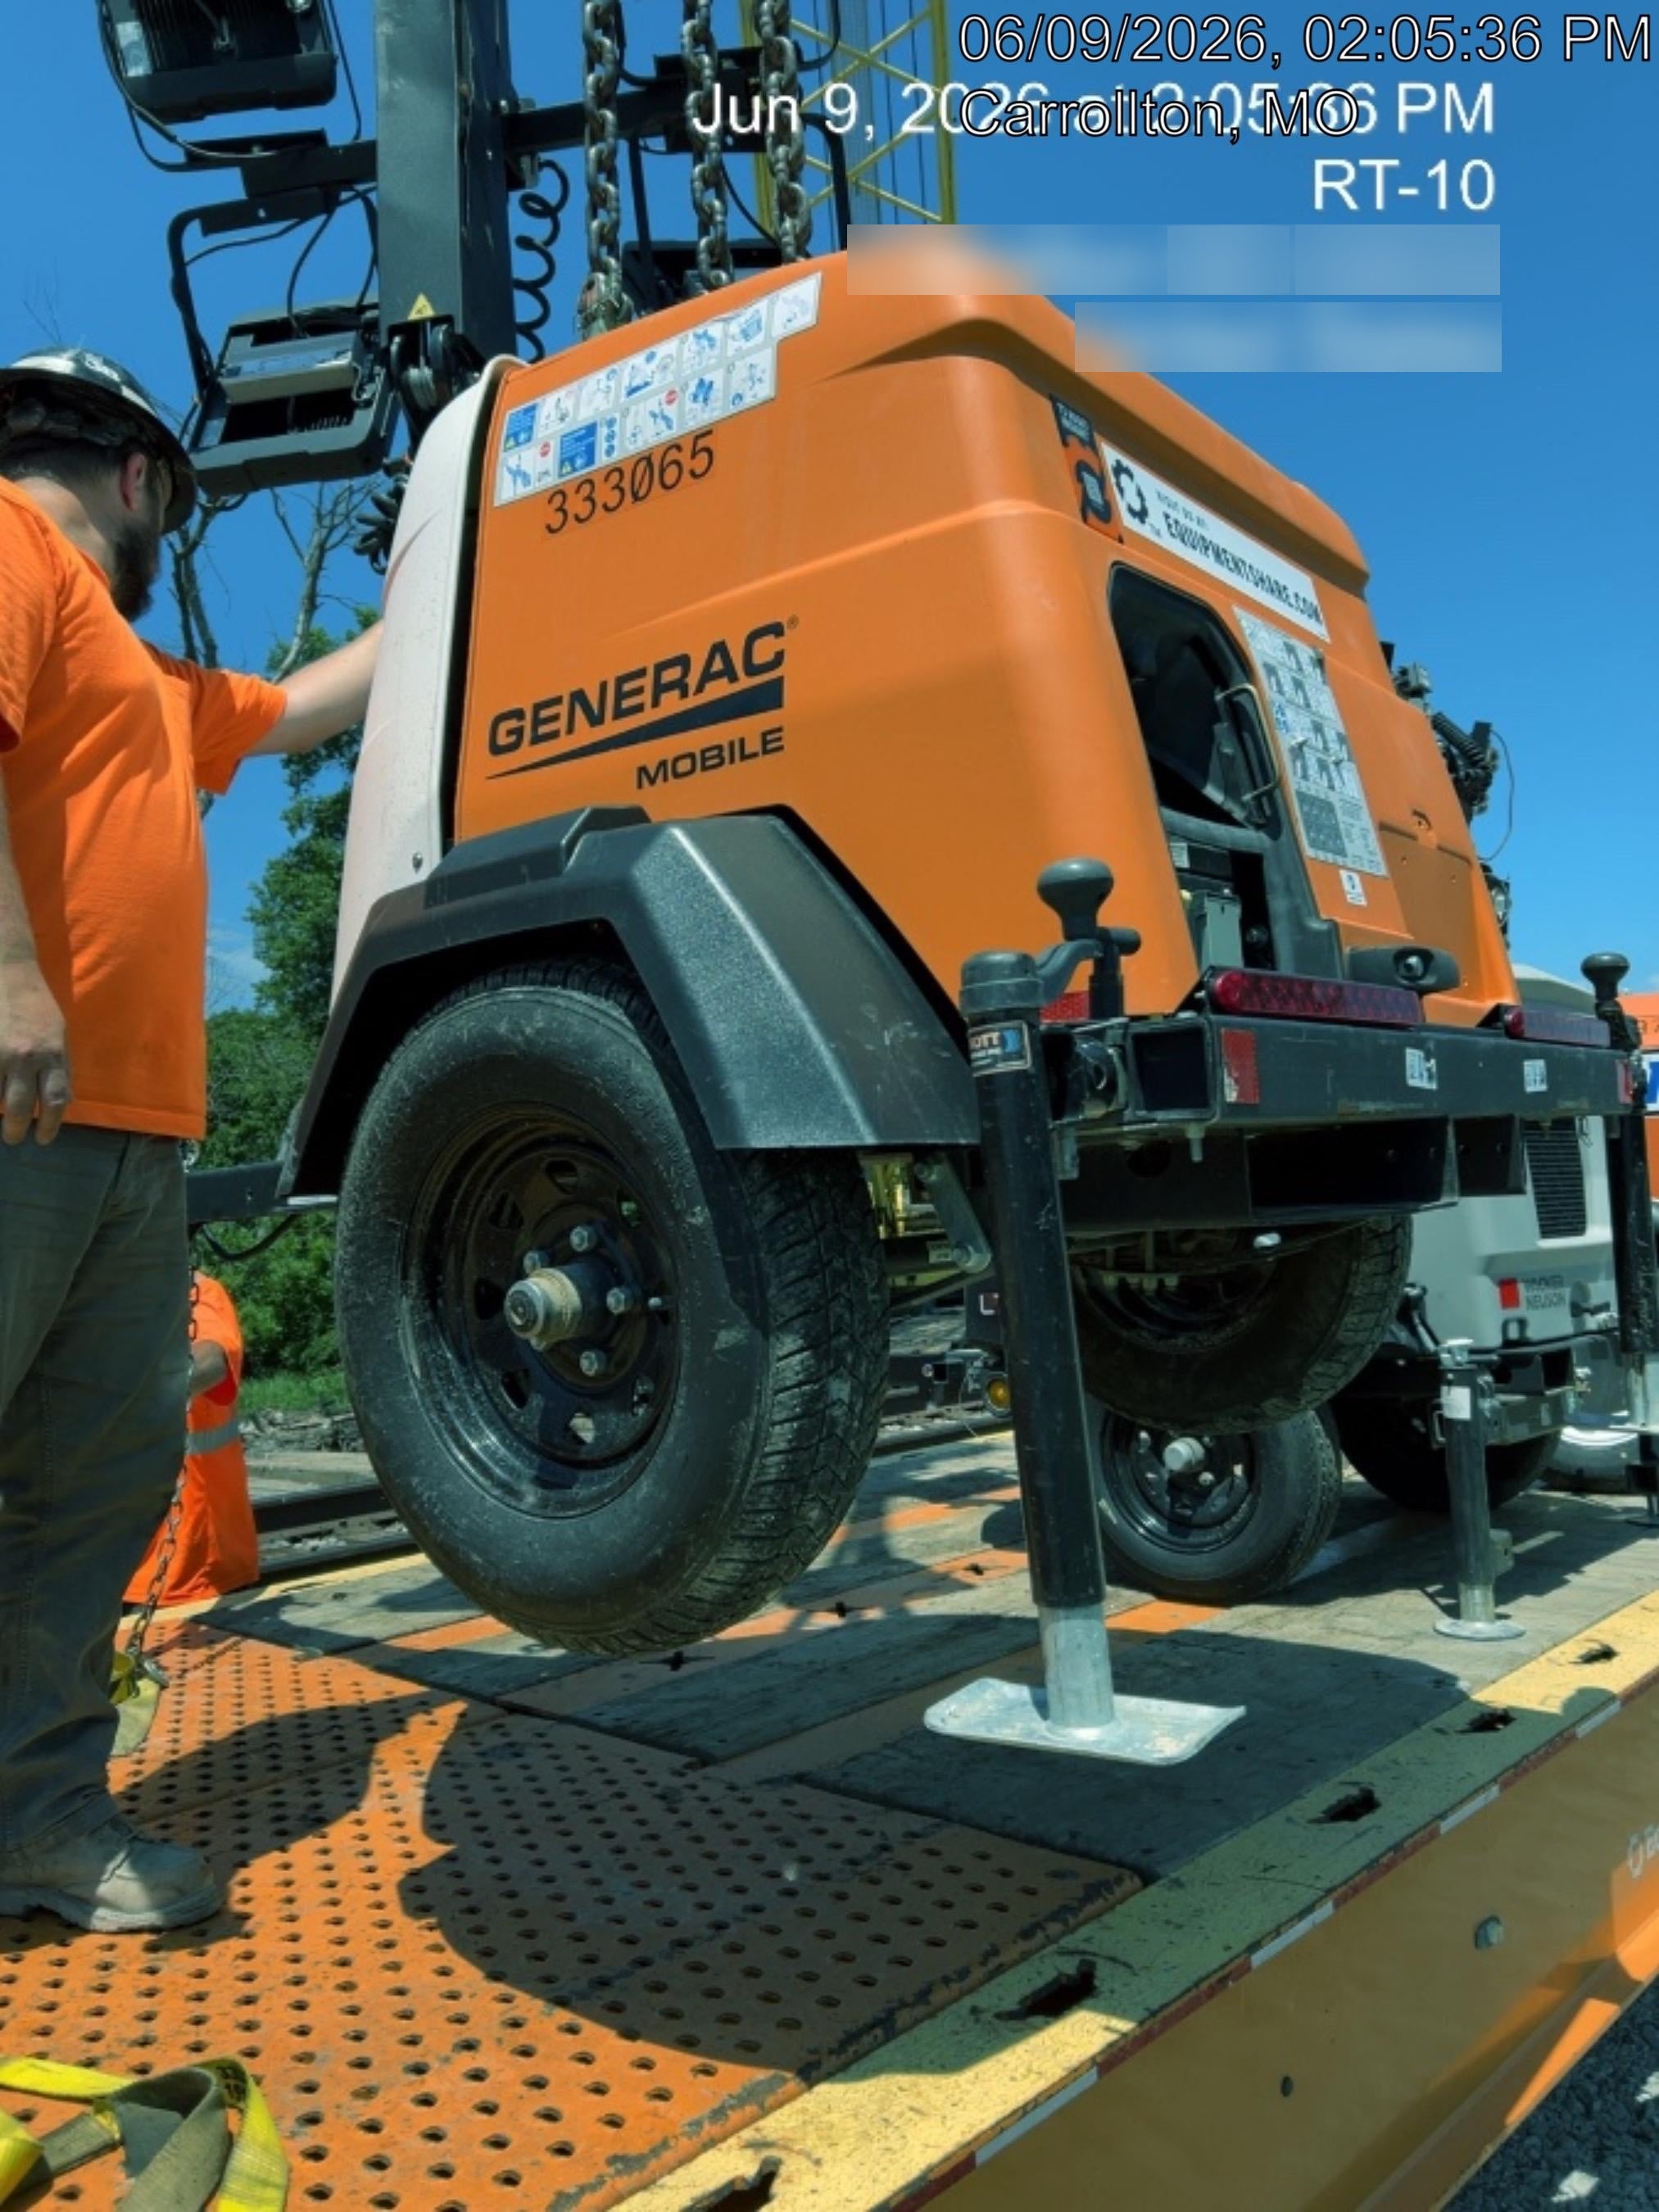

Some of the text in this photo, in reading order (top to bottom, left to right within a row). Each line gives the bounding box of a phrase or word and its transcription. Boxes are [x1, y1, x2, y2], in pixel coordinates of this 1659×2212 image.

[544, 429, 716, 534] 333065
[488, 621, 786, 756] GENERAC
[636, 726, 786, 790] MOBILE
